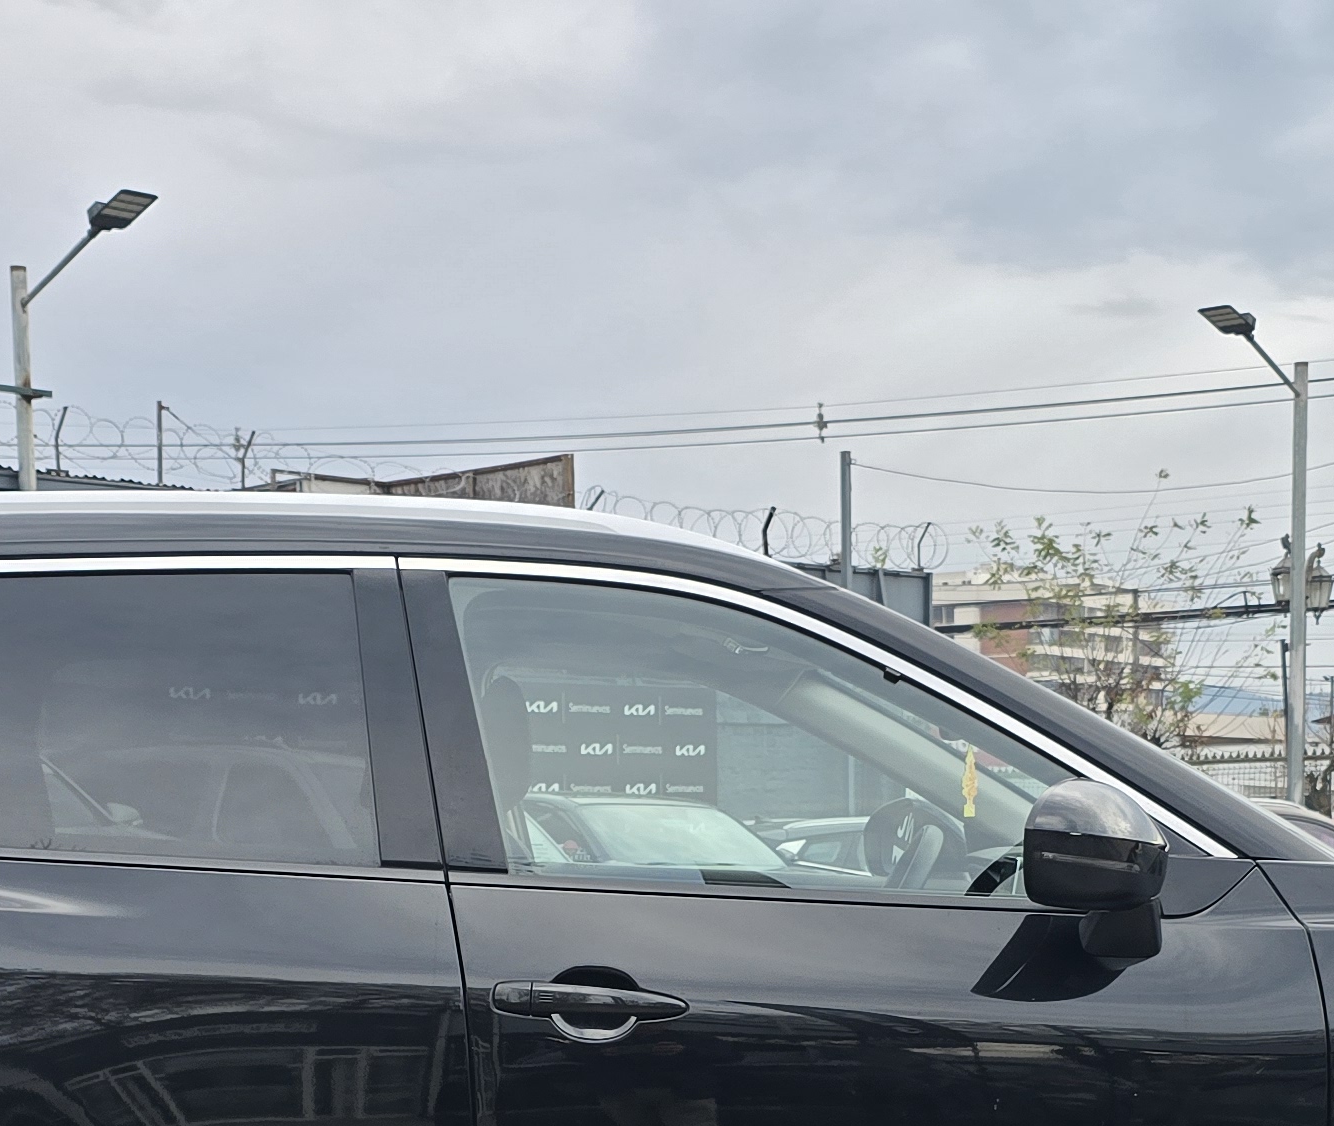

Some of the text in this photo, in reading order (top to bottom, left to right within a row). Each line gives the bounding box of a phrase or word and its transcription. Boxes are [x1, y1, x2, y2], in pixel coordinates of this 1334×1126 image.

[569, 702, 611, 714] Seminuevos
[624, 704, 704, 716] KIA Seminuevos
[580, 743, 663, 755] KIA Seminuevos
[675, 744, 706, 756] KIA
[625, 783, 657, 795] KIA
